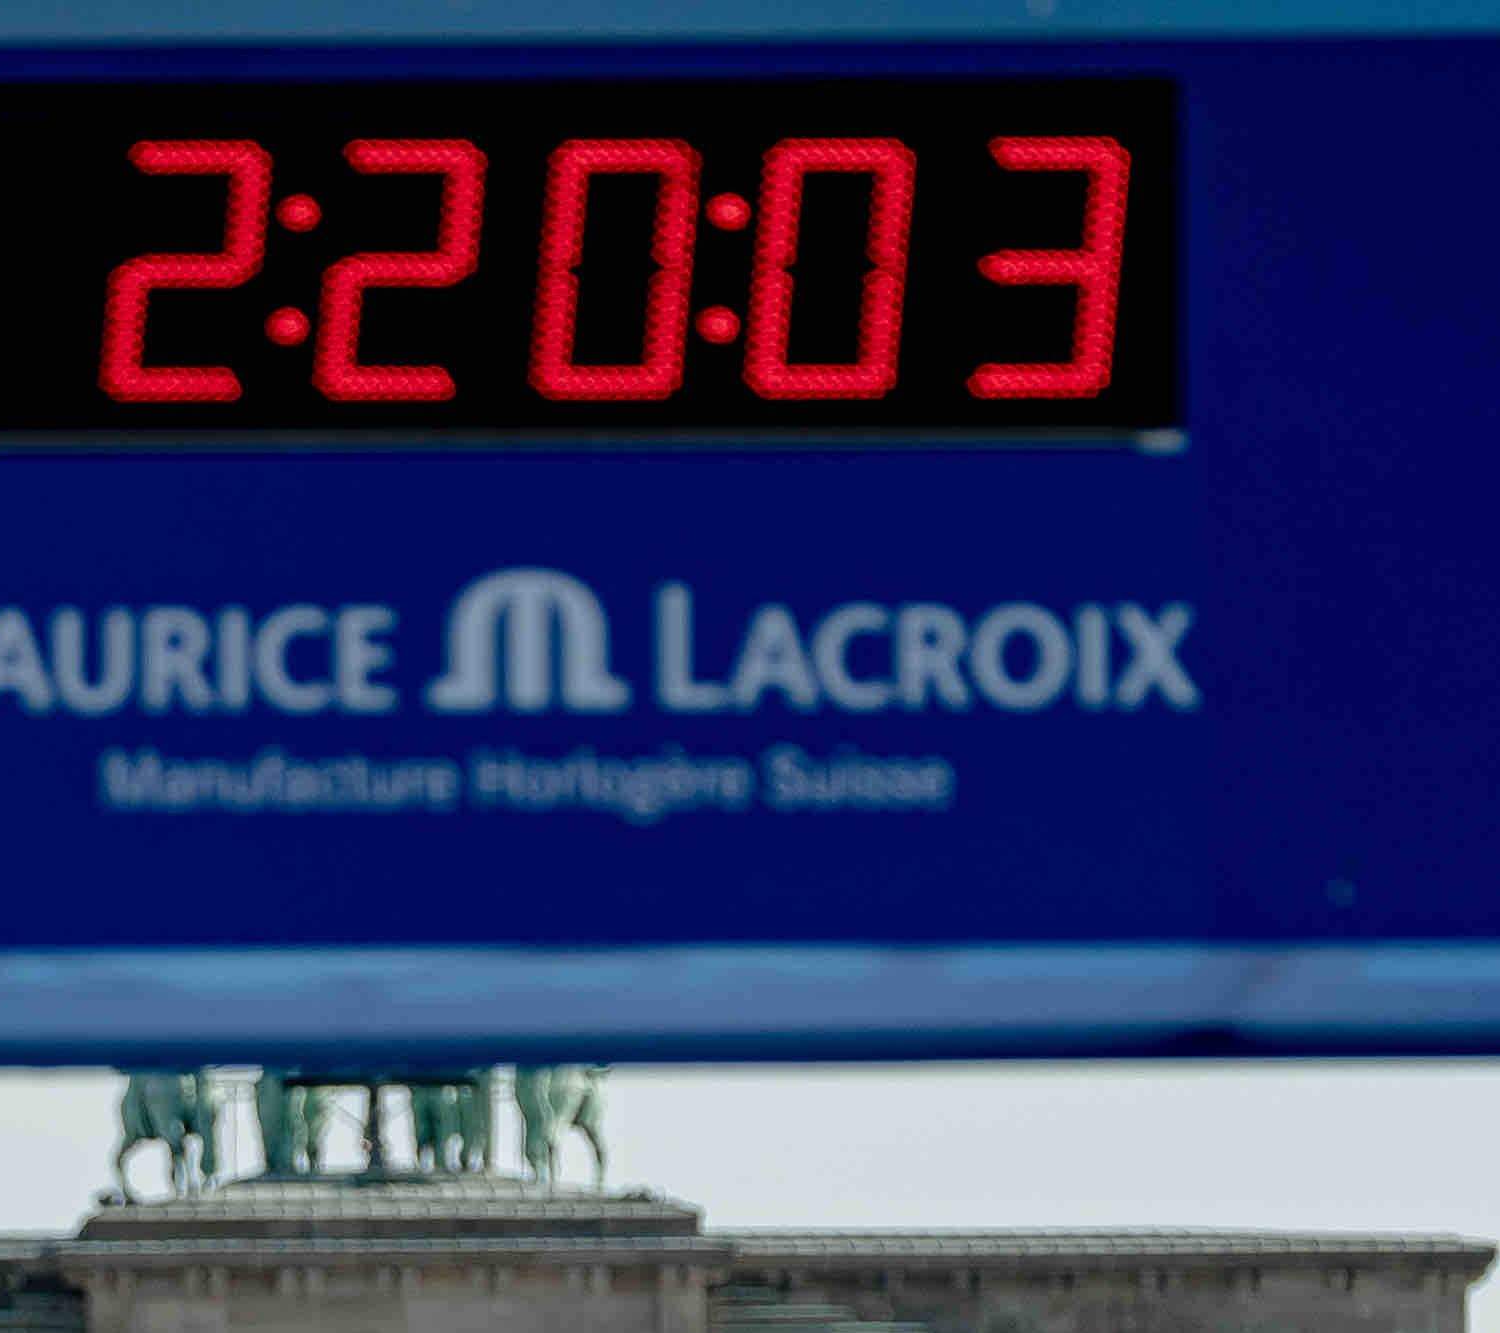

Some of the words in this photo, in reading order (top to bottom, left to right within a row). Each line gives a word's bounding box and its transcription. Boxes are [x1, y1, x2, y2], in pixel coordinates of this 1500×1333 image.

[656, 583, 1198, 712] LACROIX
[101, 750, 460, 808] Manufacture
[768, 746, 955, 808] Suisse
